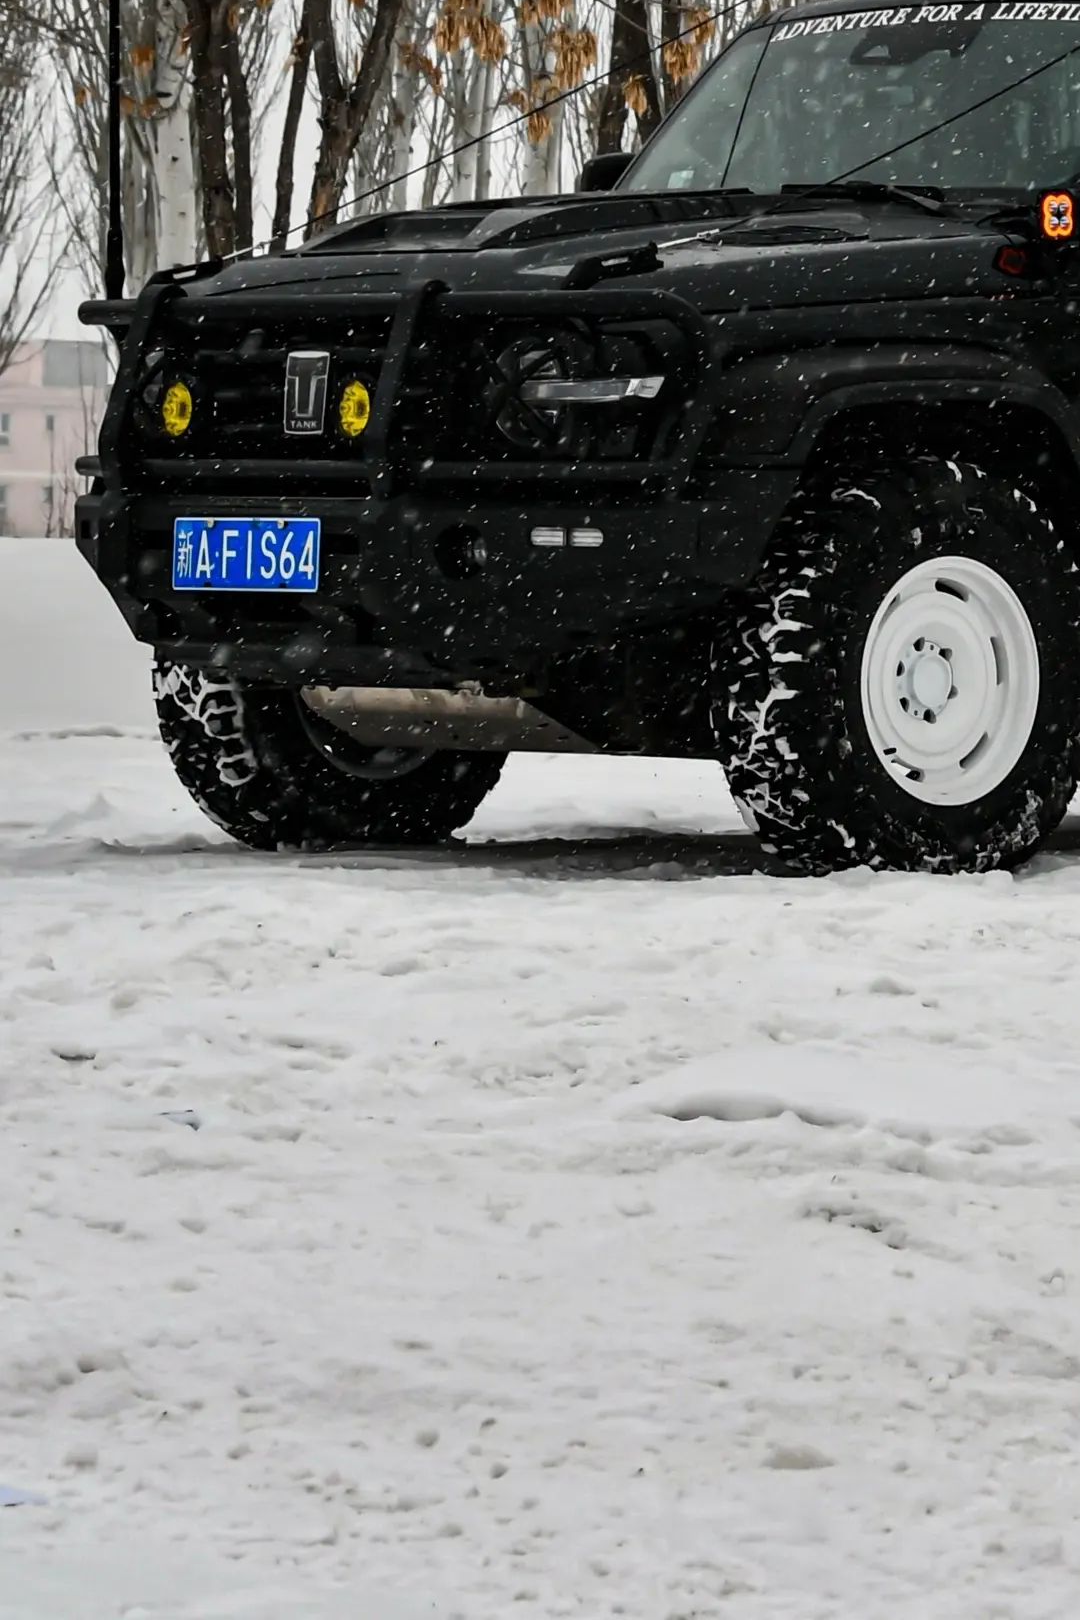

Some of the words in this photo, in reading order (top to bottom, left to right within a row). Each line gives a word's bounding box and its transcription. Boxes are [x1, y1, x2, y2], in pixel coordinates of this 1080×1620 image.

[770, 7, 911, 42] ADVENTURE
[912, 5, 962, 23] FOR
[965, 3, 985, 21] A
[290, 420, 317, 429] TANK
